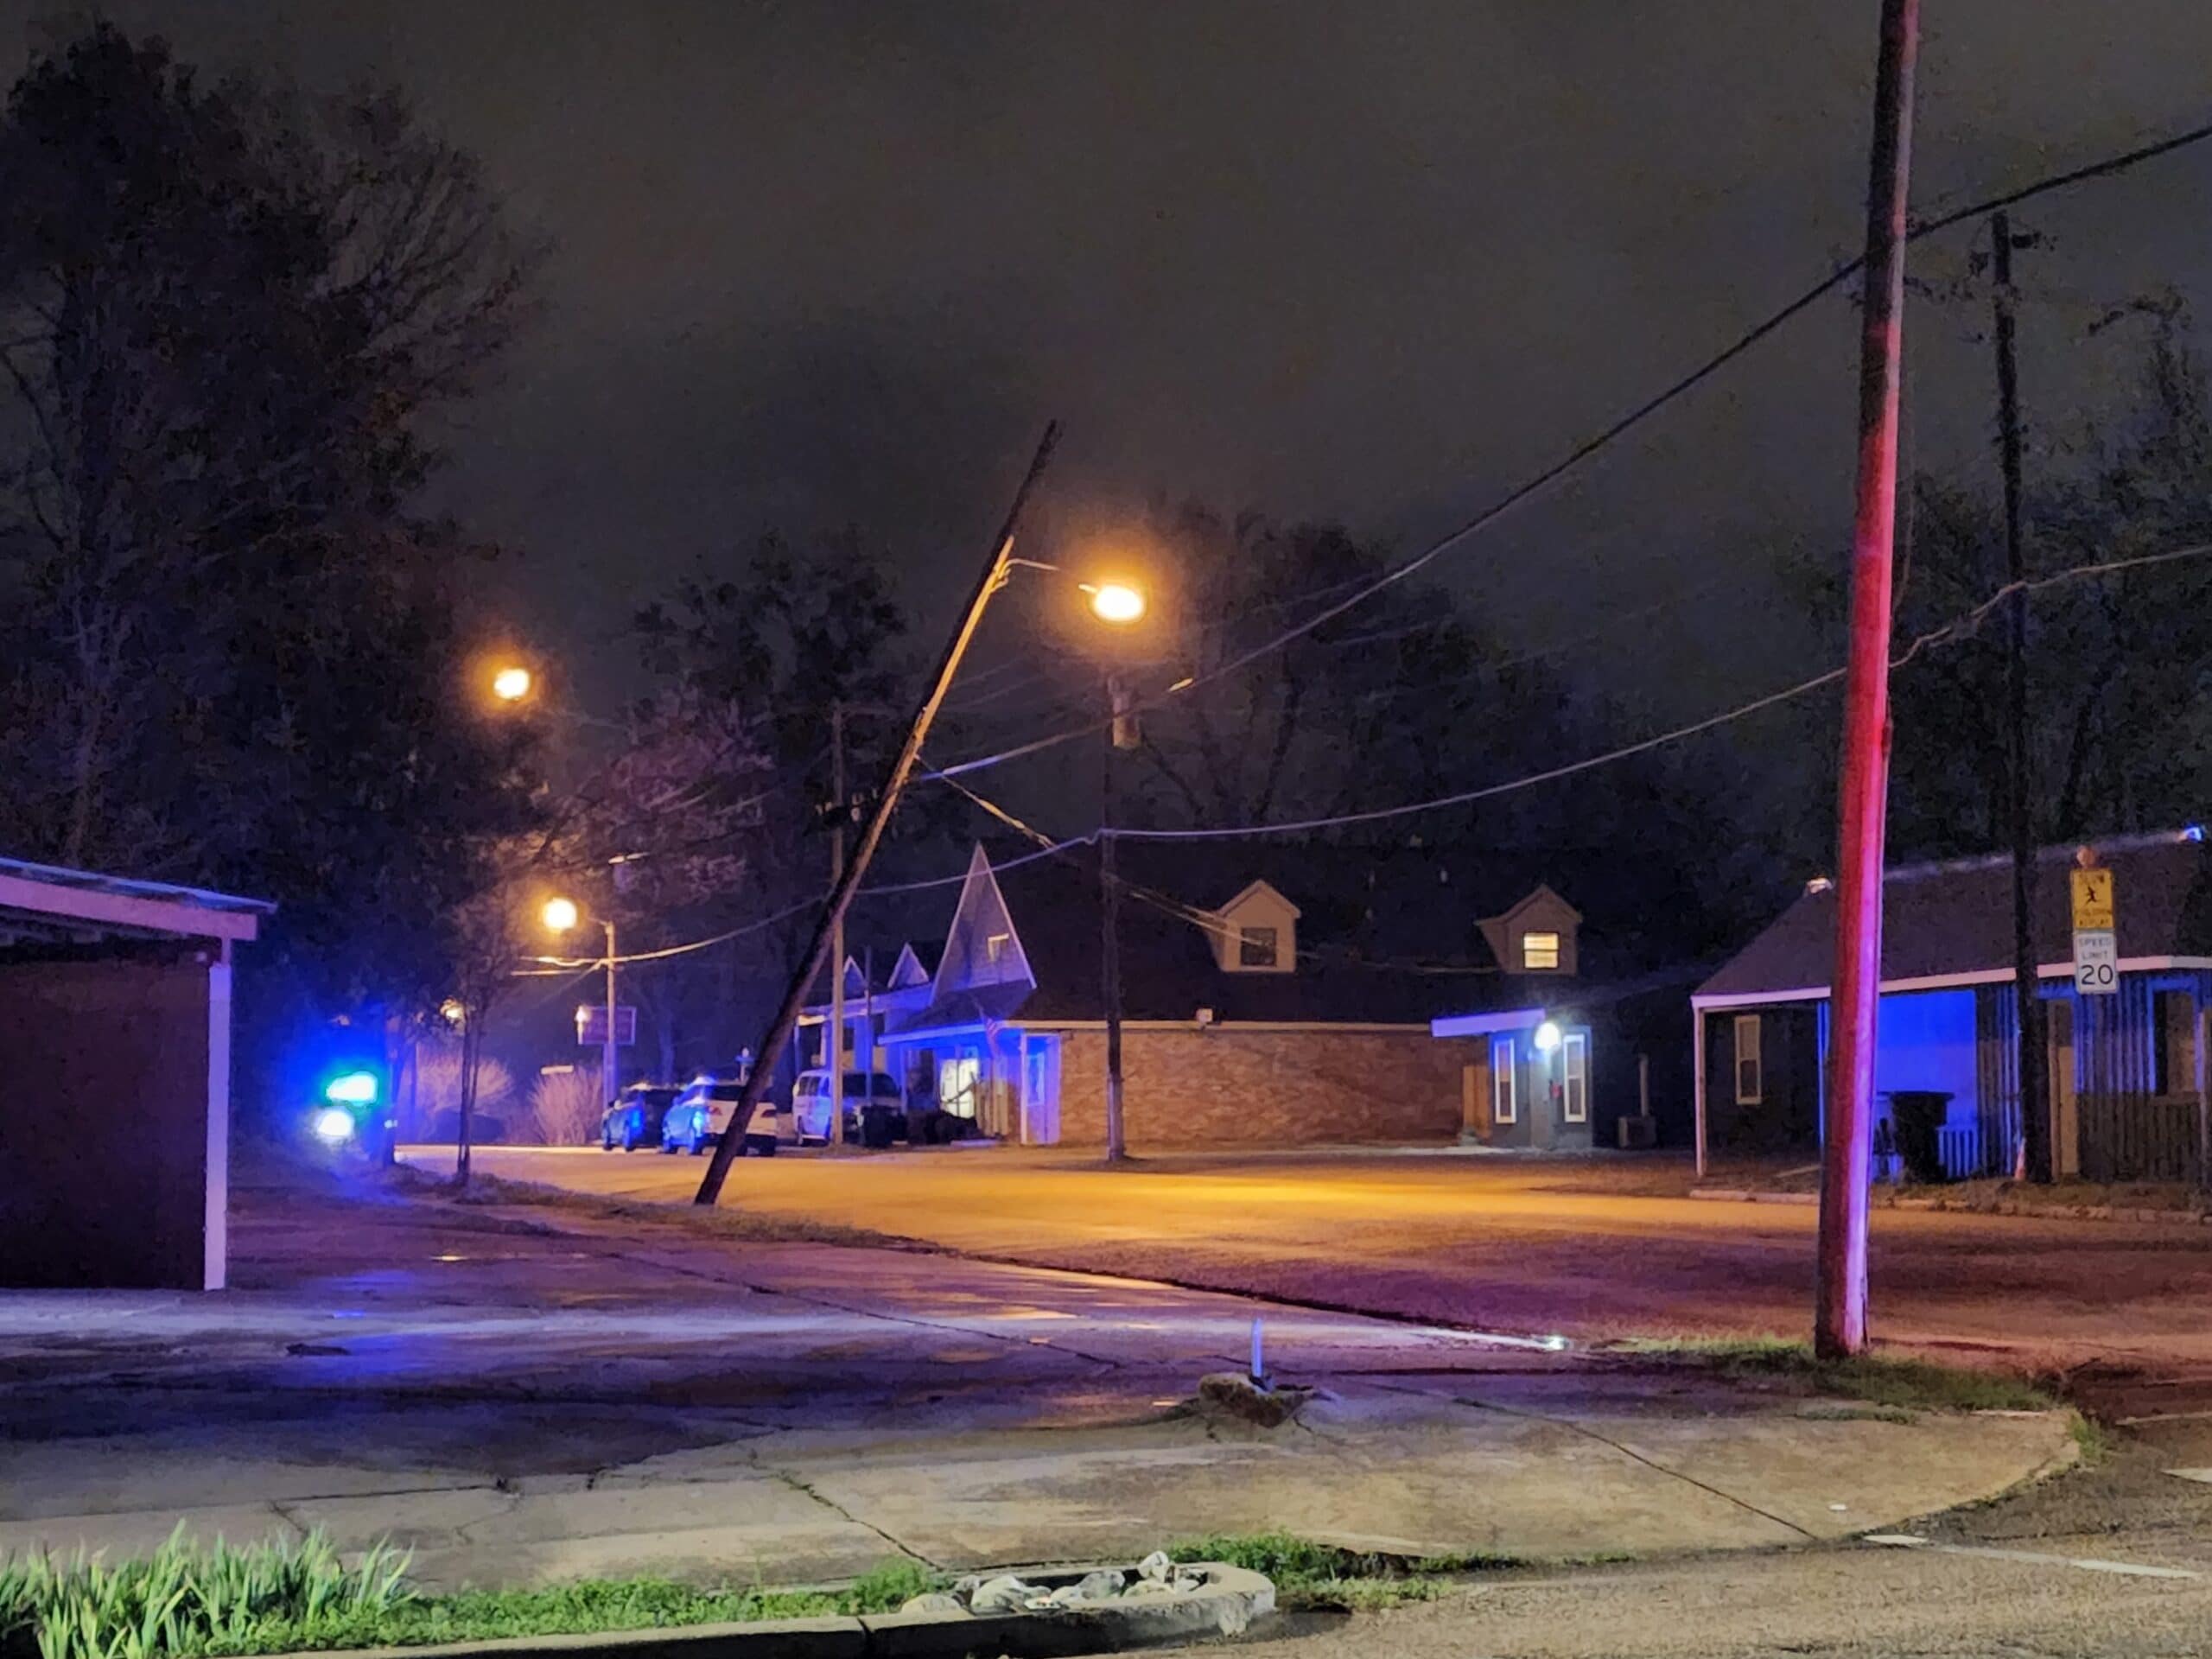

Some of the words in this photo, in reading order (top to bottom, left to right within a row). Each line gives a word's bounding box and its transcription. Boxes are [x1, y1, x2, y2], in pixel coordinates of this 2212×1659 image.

[2079, 937, 2111, 948] SPEED
[2082, 950, 2108, 960] LIMIT
[2081, 963, 2113, 985] 20
